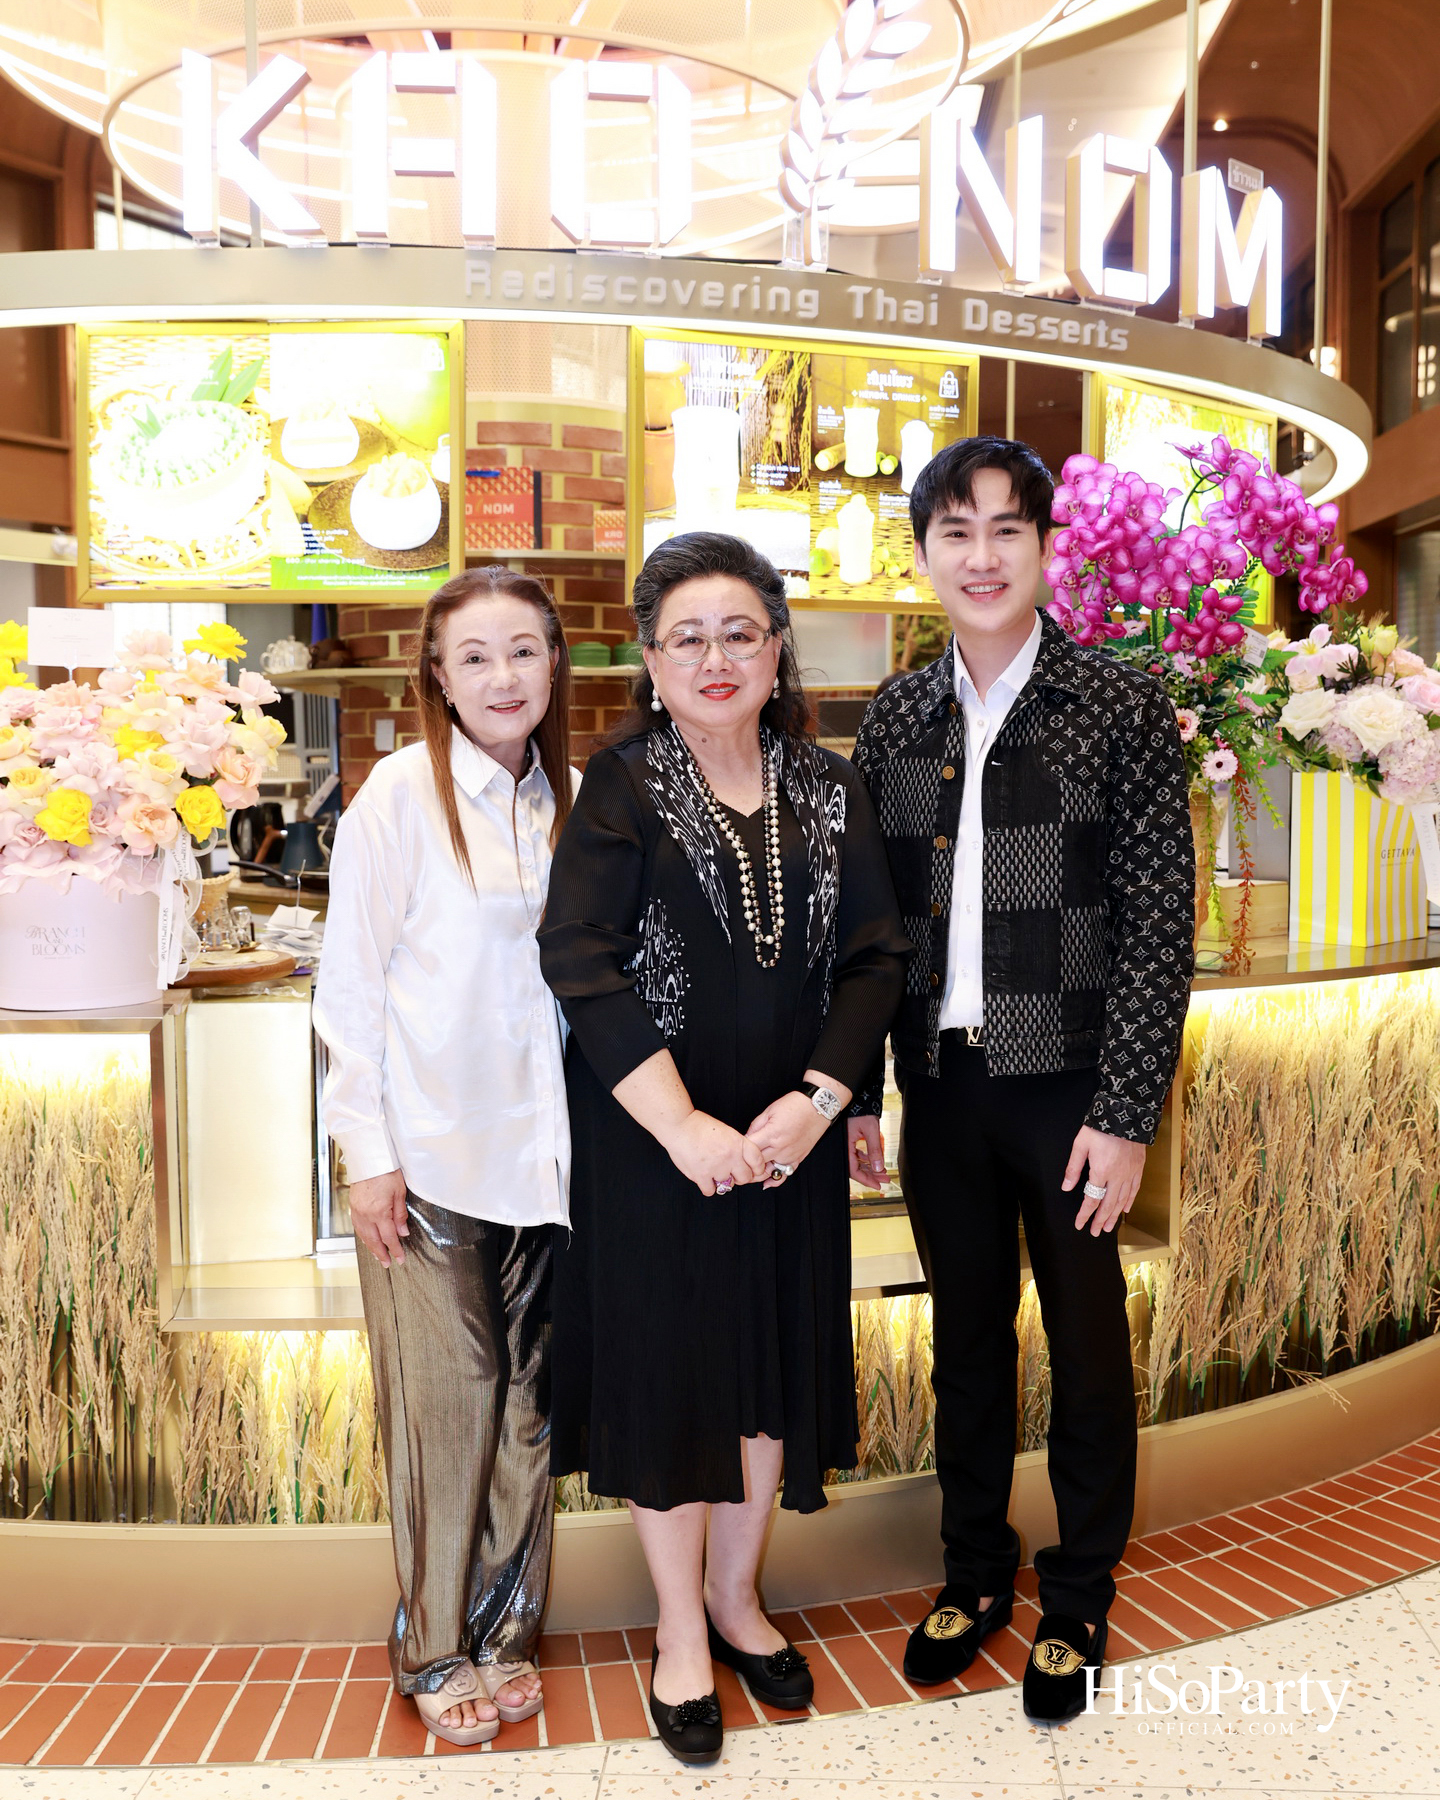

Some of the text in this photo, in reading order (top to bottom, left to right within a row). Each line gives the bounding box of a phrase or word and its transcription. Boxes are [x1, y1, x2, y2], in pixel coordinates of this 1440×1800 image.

[182, 48, 1283, 338] KAO NOM
[465, 259, 1129, 351] Rediscovering Thai Desserts
[866, 369, 914, 391] สมุนไพร
[892, 392, 921, 403] DRINKS
[483, 503, 515, 515] NOM
[604, 530, 623, 539] KAO
[1381, 848, 1415, 859] GETTAVA
